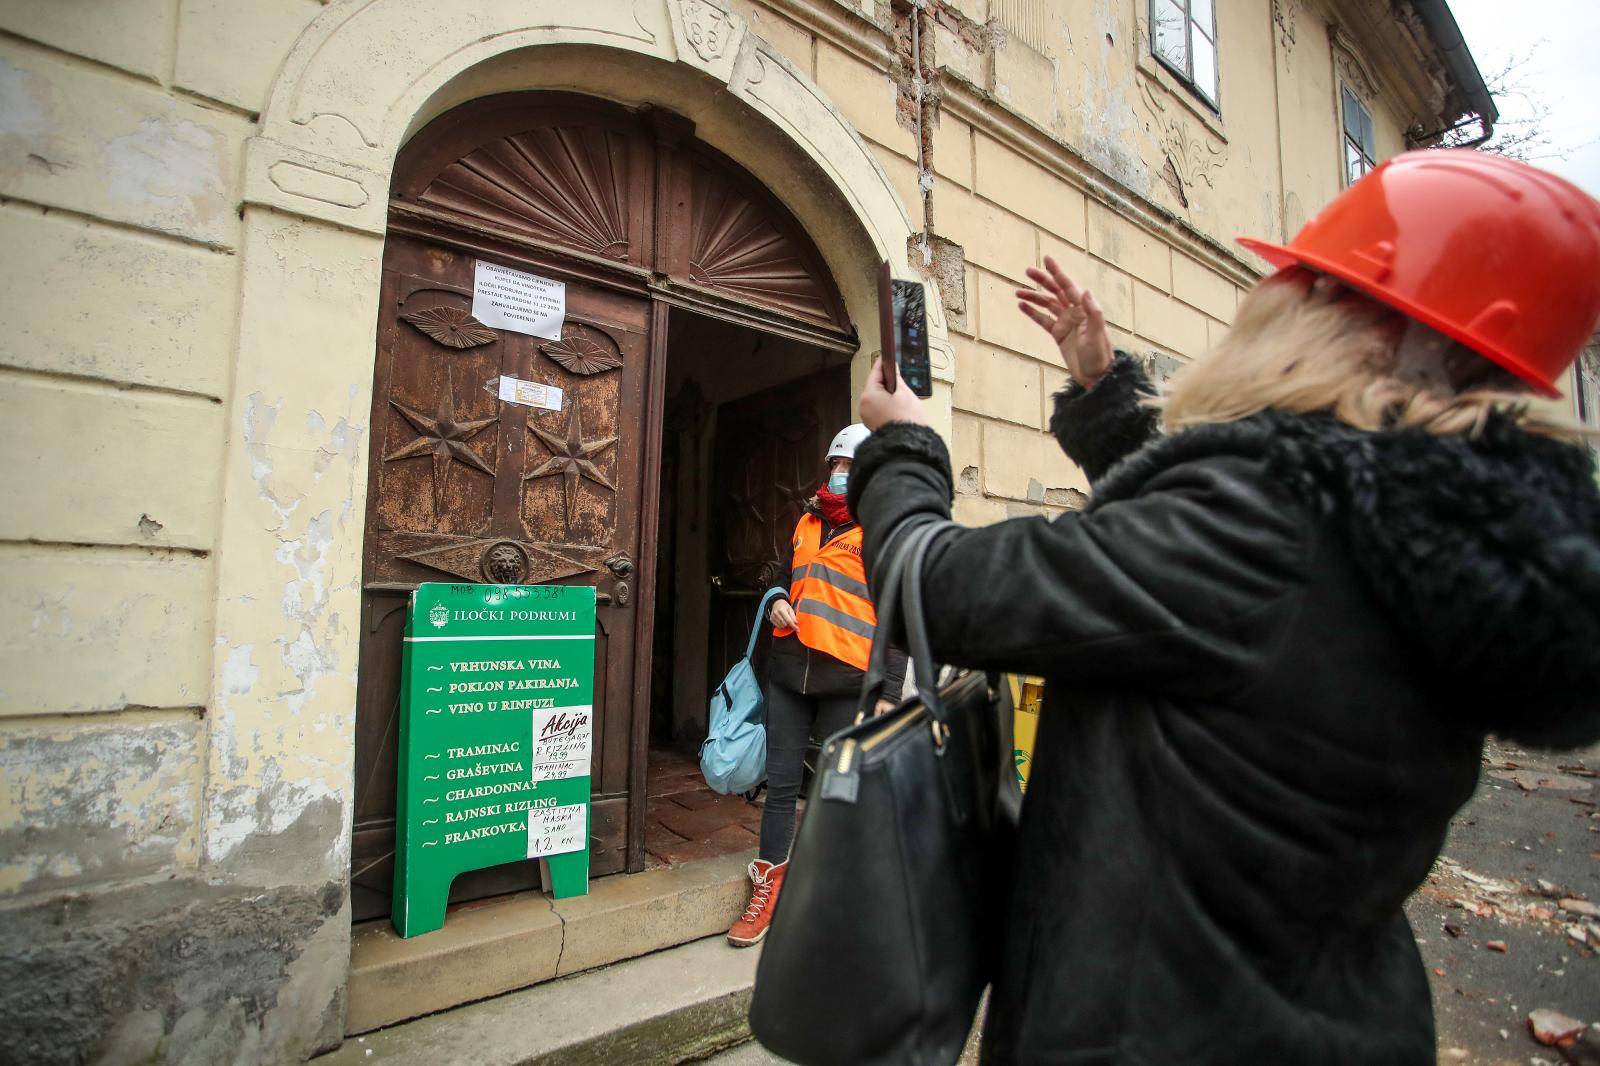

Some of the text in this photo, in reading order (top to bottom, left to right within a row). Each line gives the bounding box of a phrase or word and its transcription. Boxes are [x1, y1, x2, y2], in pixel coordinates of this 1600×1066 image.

[494, 275, 511, 283] KUPCE
[521, 283, 546, 292] VINOTEKA
[497, 285, 523, 295] PODRUMI
[478, 289, 502, 299] PRESTAJE
[511, 296, 532, 305] RADOM
[491, 301, 532, 315] ZAHVALJUJEMO
[503, 311, 536, 323] POVJERENJU
[484, 587, 509, 603] 098
[515, 586, 540, 601] 553
[454, 607, 577, 621] ILOČKI PODRUMI
[450, 659, 561, 673] VRHUNSKA VINA
[449, 678, 579, 694] POKLON PAKIRANJA
[448, 698, 555, 715] VINO U RINFUZI
[541, 712, 588, 737] Akcija
[447, 742, 520, 760] TRAMINAC
[446, 761, 524, 780] GRAŠEVINA
[533, 762, 575, 773] TRAMINAC
[445, 781, 538, 802] CHARDONNAY
[445, 797, 557, 824] RAJNSKI RIZLING
[543, 813, 572, 824] MASKA
[444, 822, 527, 845] FRANKOVKA
[544, 824, 567, 834] SAMO
